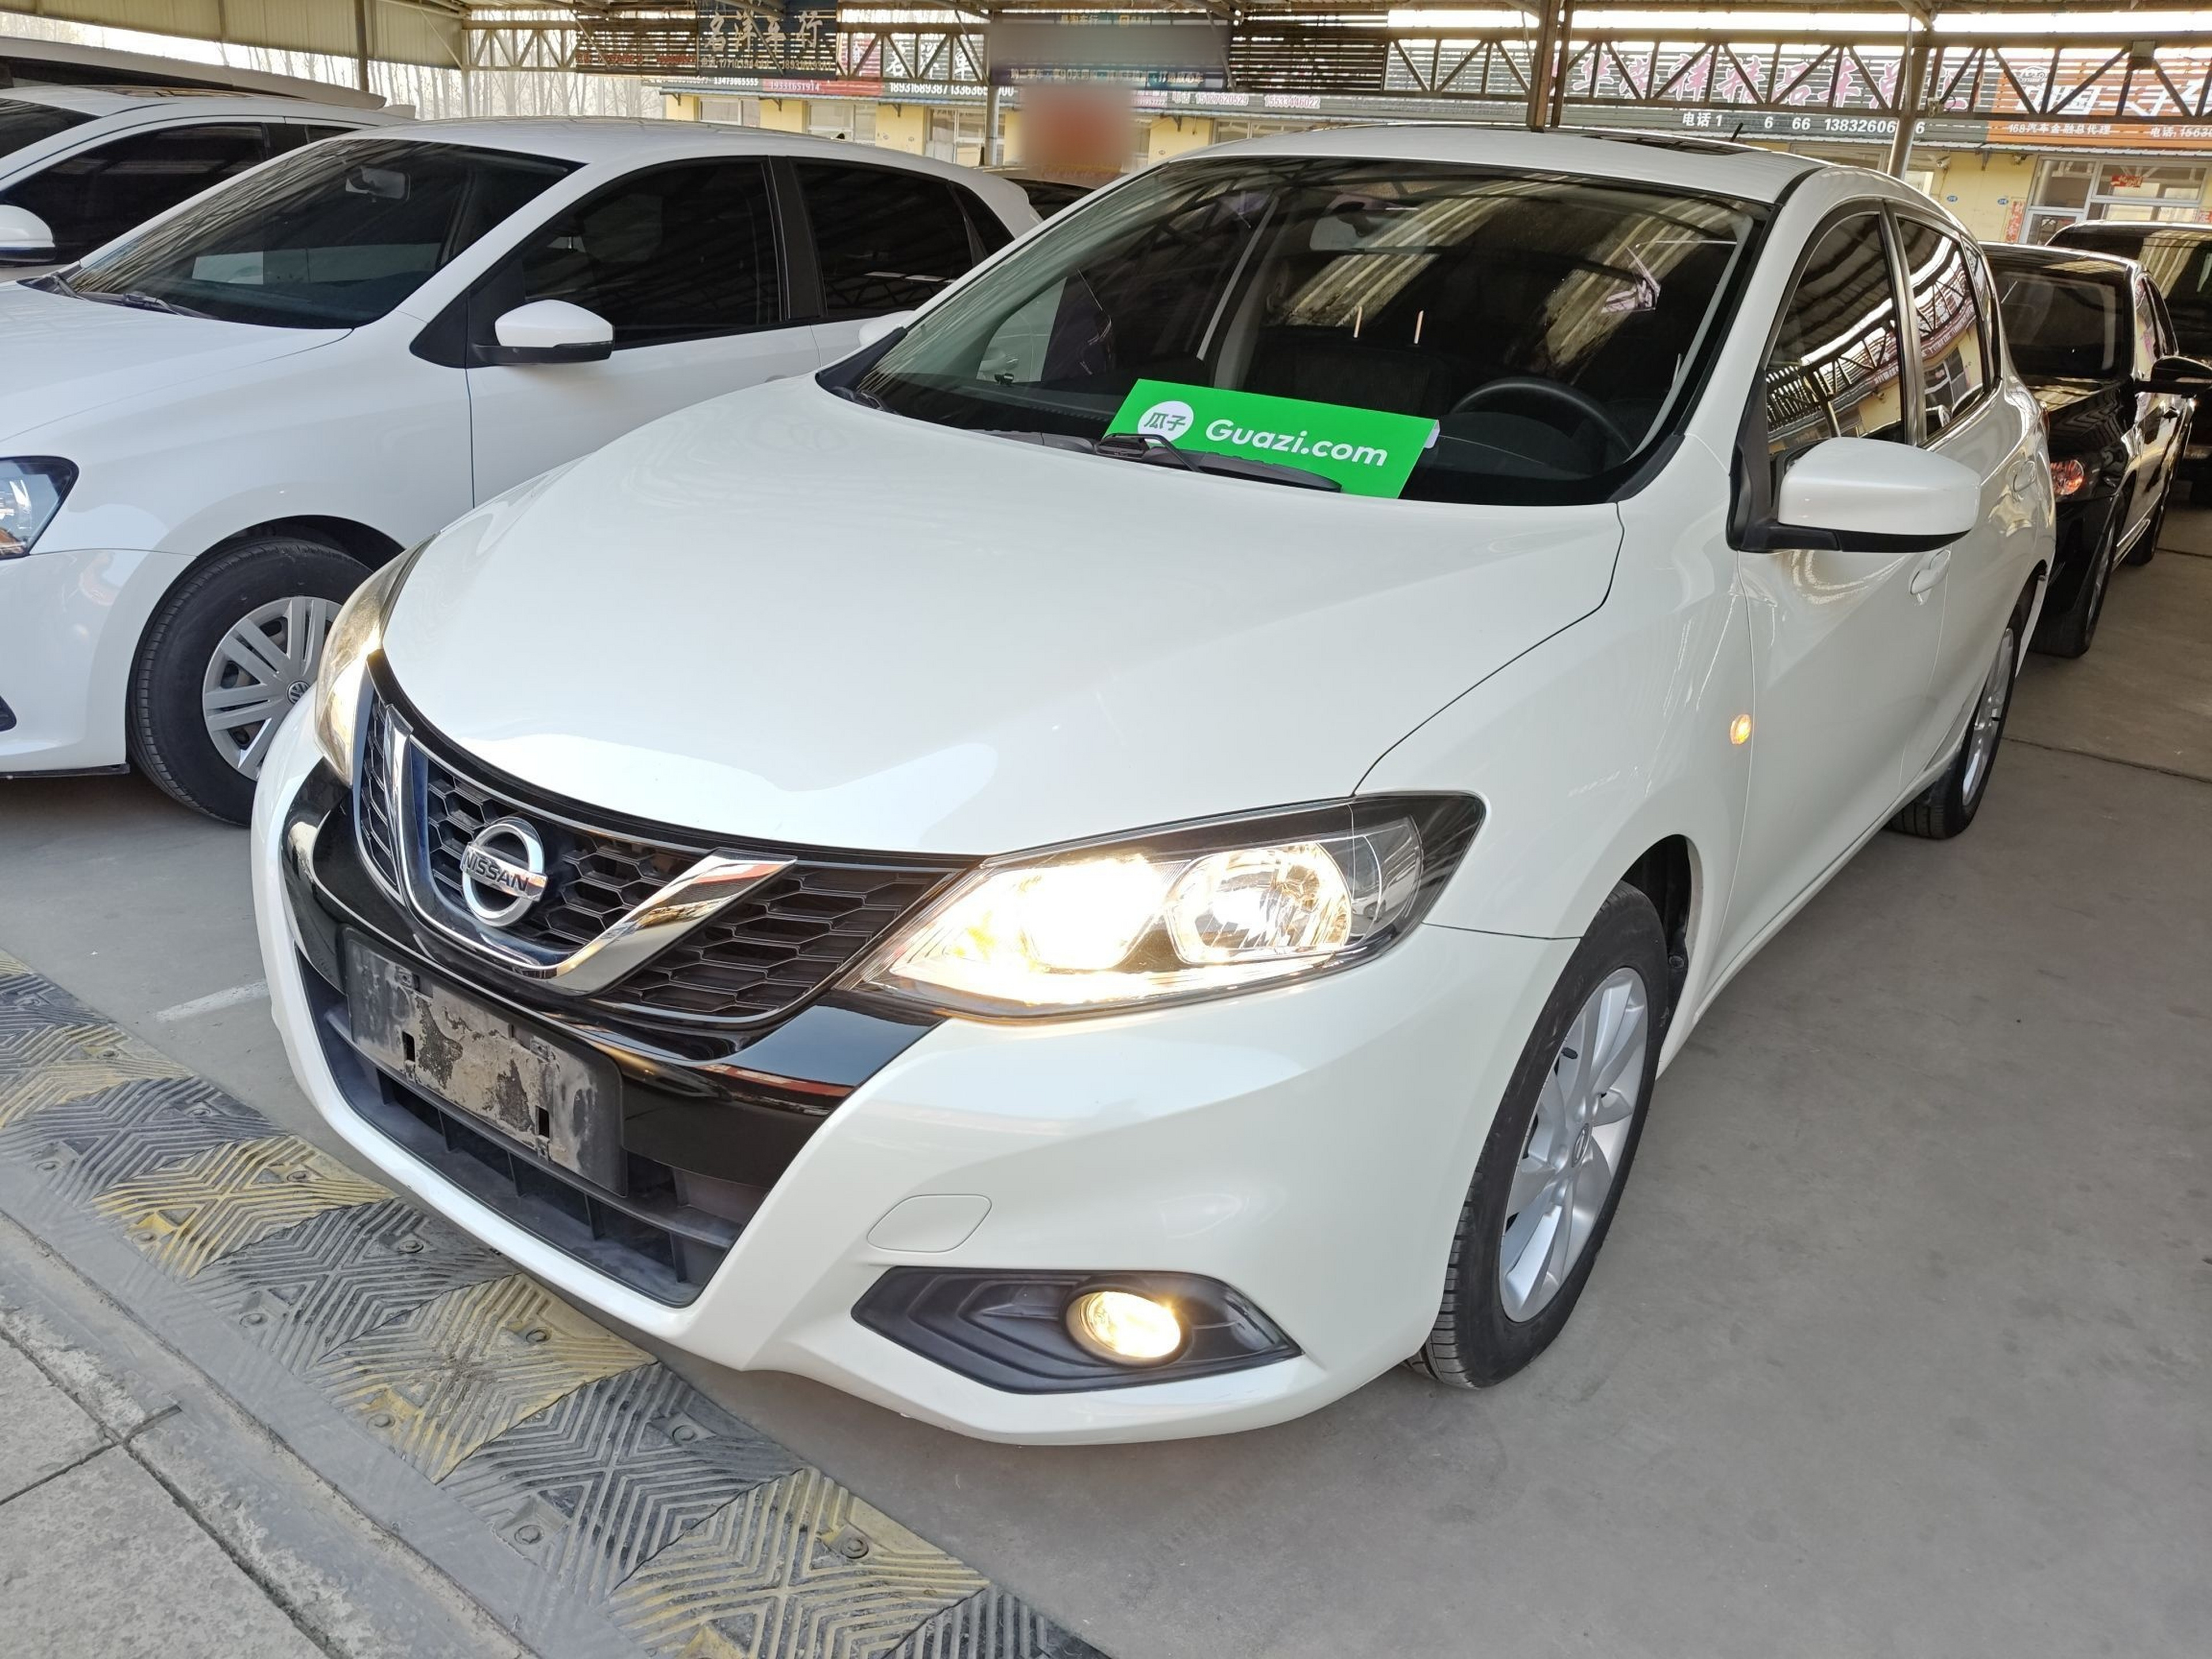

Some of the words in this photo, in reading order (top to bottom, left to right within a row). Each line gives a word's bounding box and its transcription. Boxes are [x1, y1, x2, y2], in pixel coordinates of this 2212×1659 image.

[1682, 113, 1710, 127] 电话
[1144, 412, 1187, 431] 瓜子
[1206, 418, 1388, 467] Guazi.com
[464, 851, 529, 892] NISSAN
